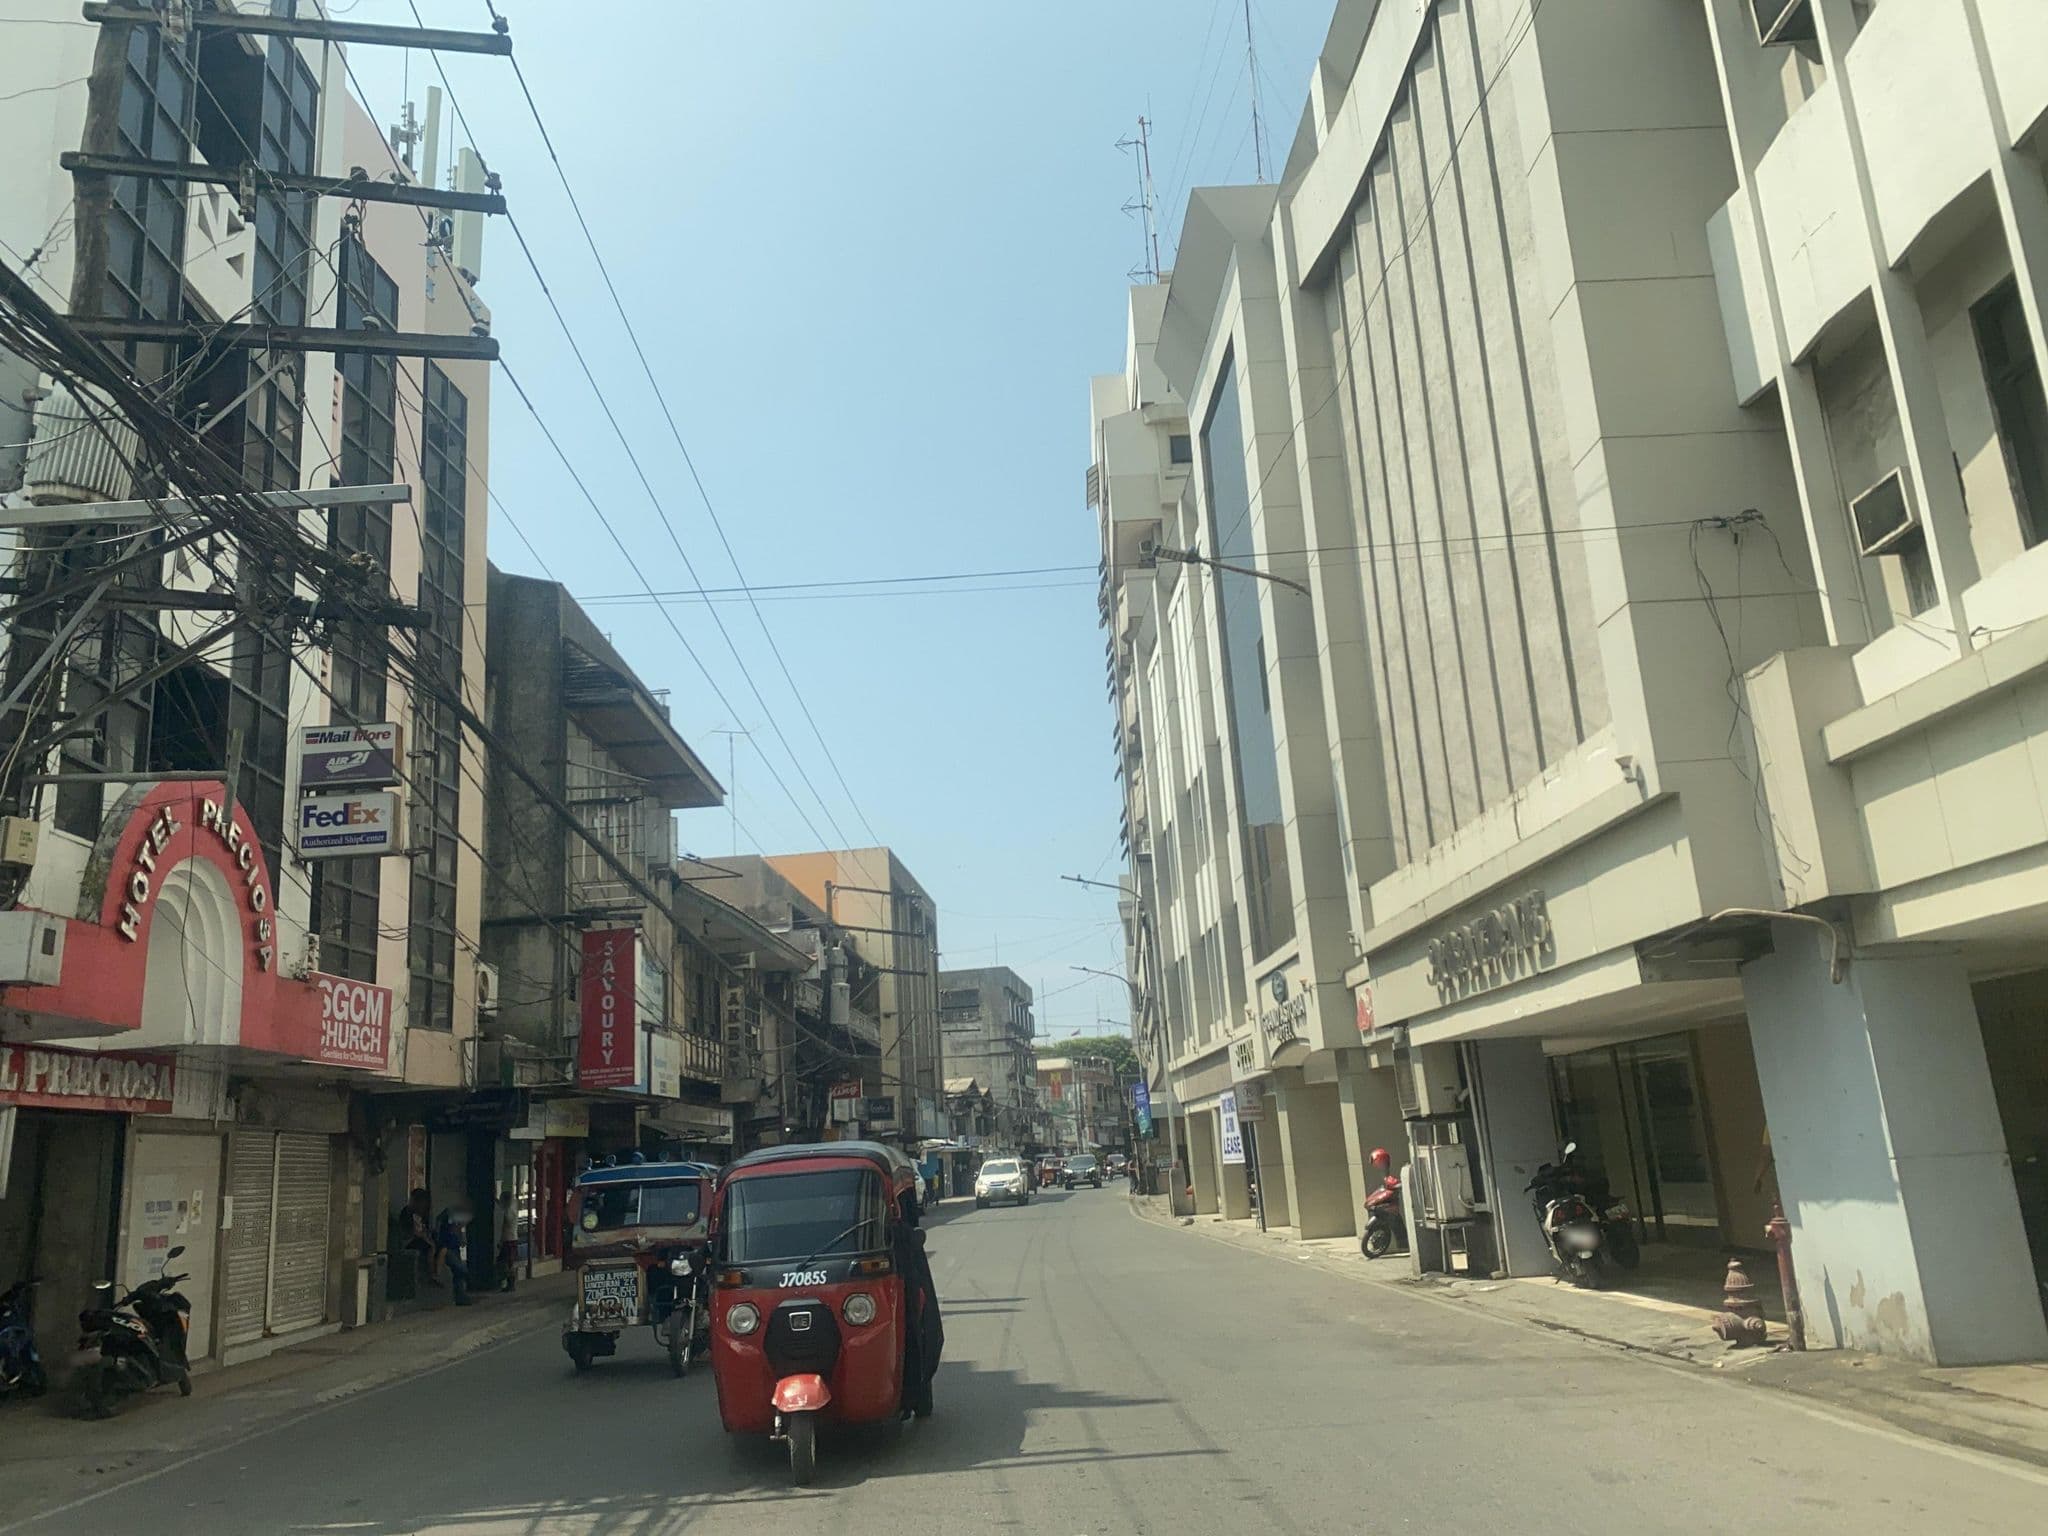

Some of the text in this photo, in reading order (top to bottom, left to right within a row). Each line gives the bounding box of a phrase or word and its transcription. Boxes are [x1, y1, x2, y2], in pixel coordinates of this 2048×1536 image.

[319, 730, 391, 744] Mail More
[327, 751, 370, 767] AIR 21
[303, 801, 381, 828] FedEx
[303, 834, 385, 847] Authorized ShipCenter
[117, 805, 182, 943] HOTEL
[601, 940, 615, 1065] SAVOURY
[321, 1019, 381, 1053] HURCH
[1223, 1135, 1242, 1154] LEASE
